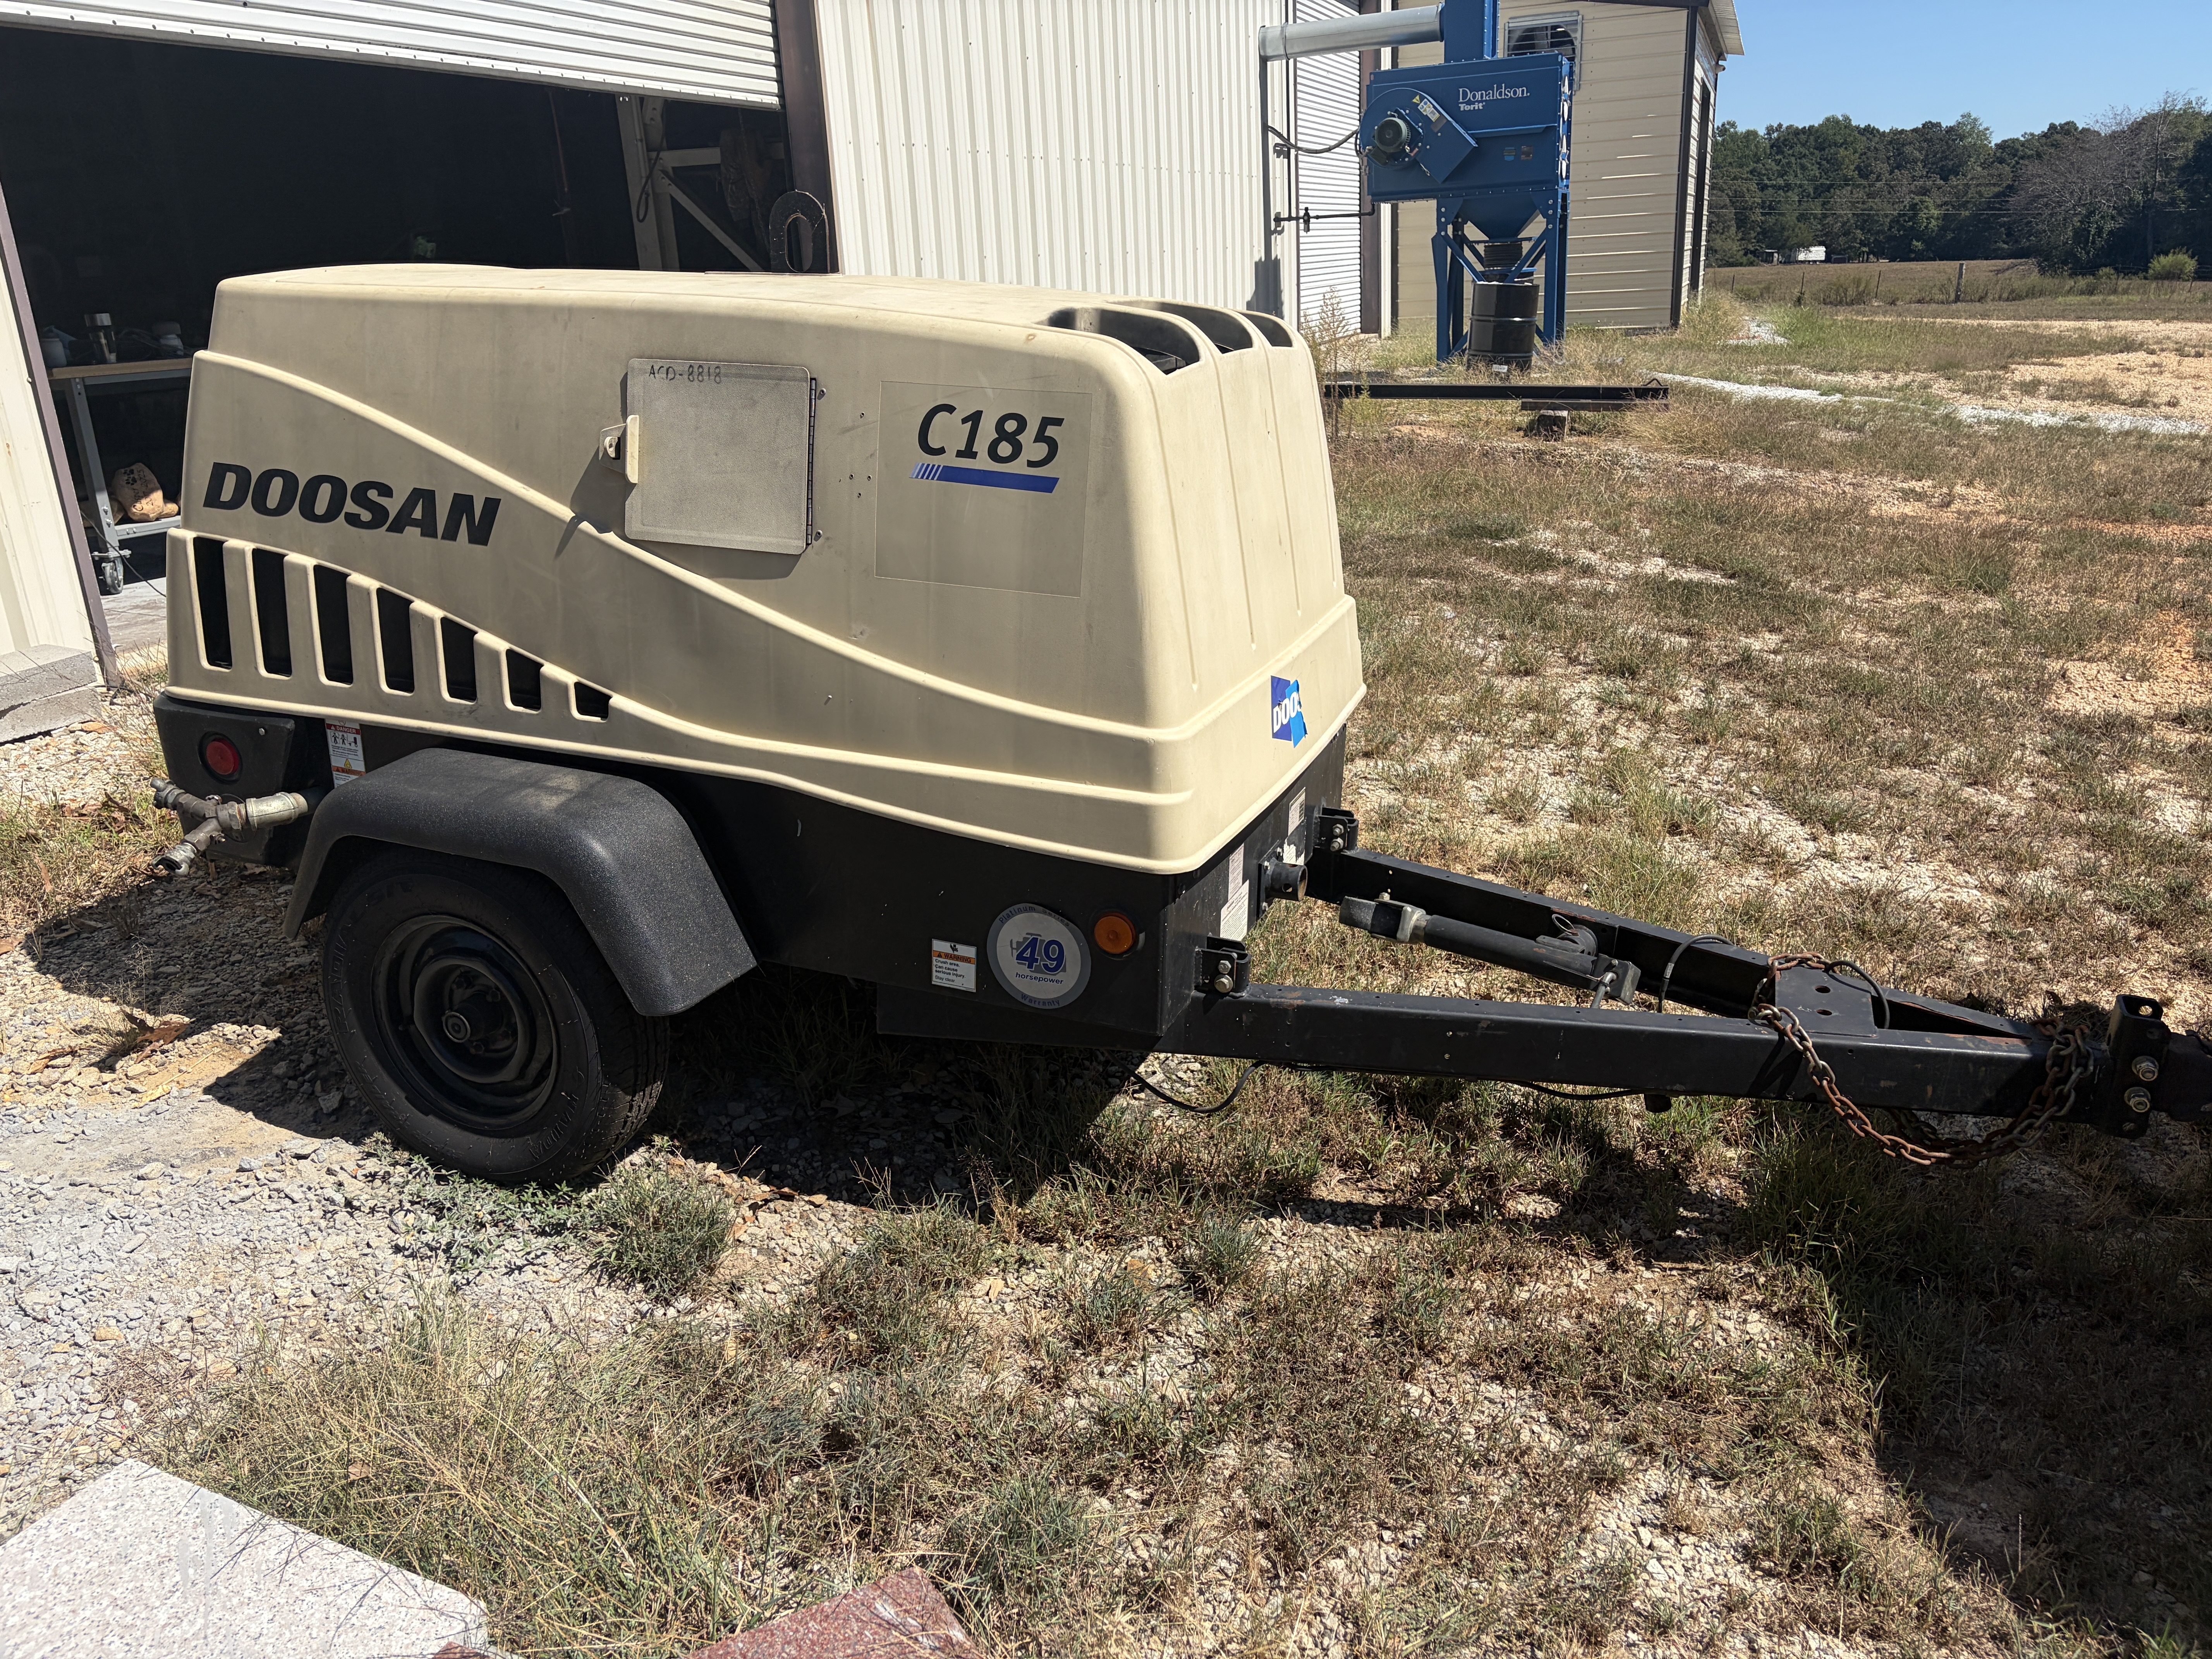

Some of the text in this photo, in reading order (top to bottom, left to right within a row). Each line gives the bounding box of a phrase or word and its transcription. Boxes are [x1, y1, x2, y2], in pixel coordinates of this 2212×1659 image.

[918, 404, 1065, 468] C185
[203, 462, 501, 546] DOOSAN
[999, 905, 1070, 927] Platinum Series
[944, 953, 971, 963] WARNING
[1015, 936, 1065, 974] 49
[1015, 972, 1064, 985] horsepower
[1021, 994, 1060, 1006] Warranty
